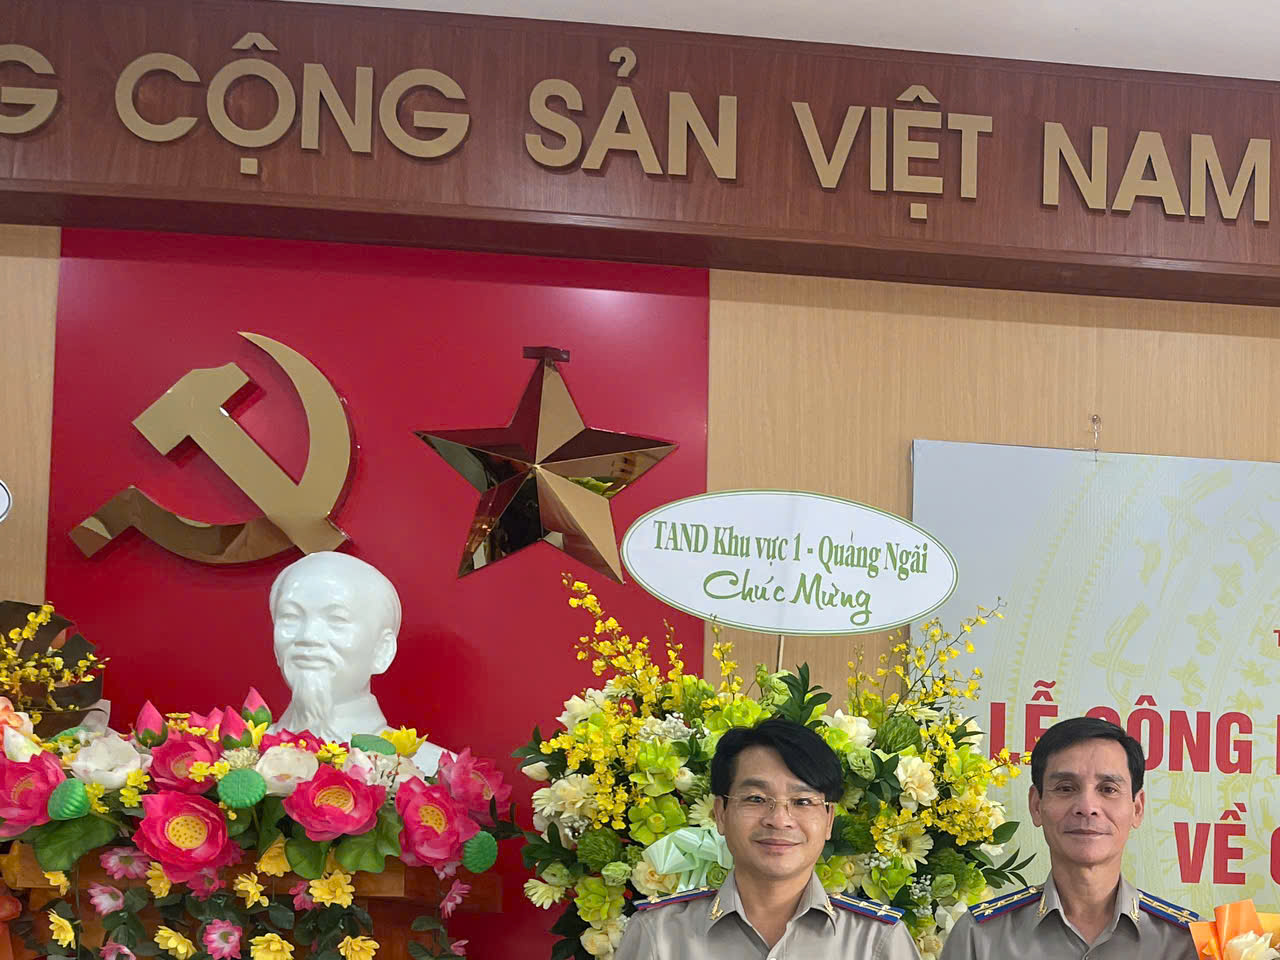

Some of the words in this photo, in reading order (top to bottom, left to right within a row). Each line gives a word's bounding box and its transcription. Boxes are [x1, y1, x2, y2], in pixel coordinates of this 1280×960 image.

[114, 32, 471, 175] CỘNG
[526, 46, 738, 181] SẢN
[791, 84, 993, 220] VIỆT
[1042, 121, 1271, 223] NAM
[653, 520, 708, 553] TAND
[712, 525, 750, 559] Khu
[755, 534, 788, 566] vực
[793, 532, 801, 562] 1
[818, 531, 881, 578] Quảng
[884, 542, 928, 580] Ngãi
[703, 568, 785, 603] Chúc
[790, 572, 873, 626] Mừng
[1085, 695, 1253, 775] ÔNG
[1173, 802, 1247, 885] VỀ
